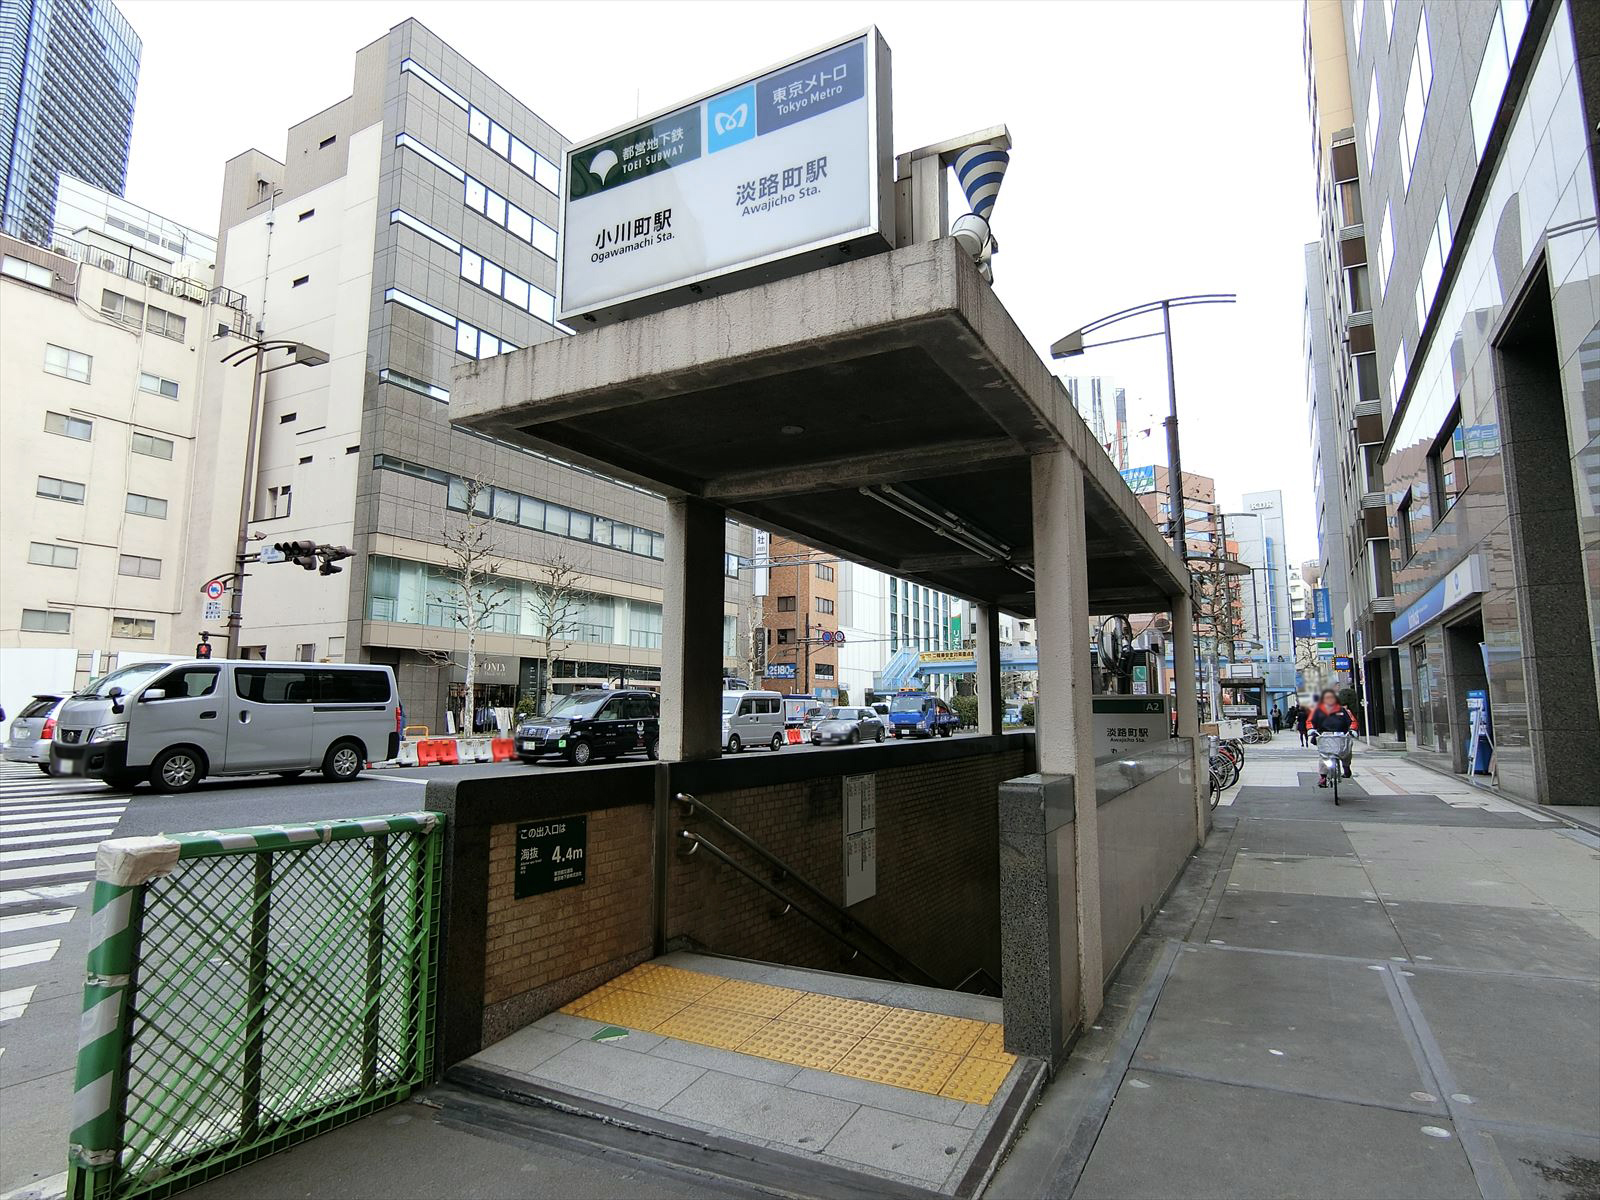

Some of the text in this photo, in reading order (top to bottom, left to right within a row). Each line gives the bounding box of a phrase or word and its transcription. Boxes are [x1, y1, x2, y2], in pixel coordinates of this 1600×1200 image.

[772, 63, 847, 104] 東京メトロ
[777, 84, 843, 116] Tokyo Metro
[622, 127, 684, 161] 都営地下鉄
[622, 143, 684, 174] TOEI SUBWAY
[735, 156, 828, 206] 淡路町駅
[742, 186, 821, 217] Awajicho Sta.
[595, 208, 672, 250] 小川町駅
[591, 231, 675, 264] Ogawamachi Sta.
[484, 662, 505, 672] ONLY
[1146, 702, 1160, 711] A2
[1106, 727, 1149, 738] 淡路町駅
[520, 823, 566, 840] この出入口は
[520, 847, 539, 861] 海抜
[551, 845, 583, 863] 4.4m
